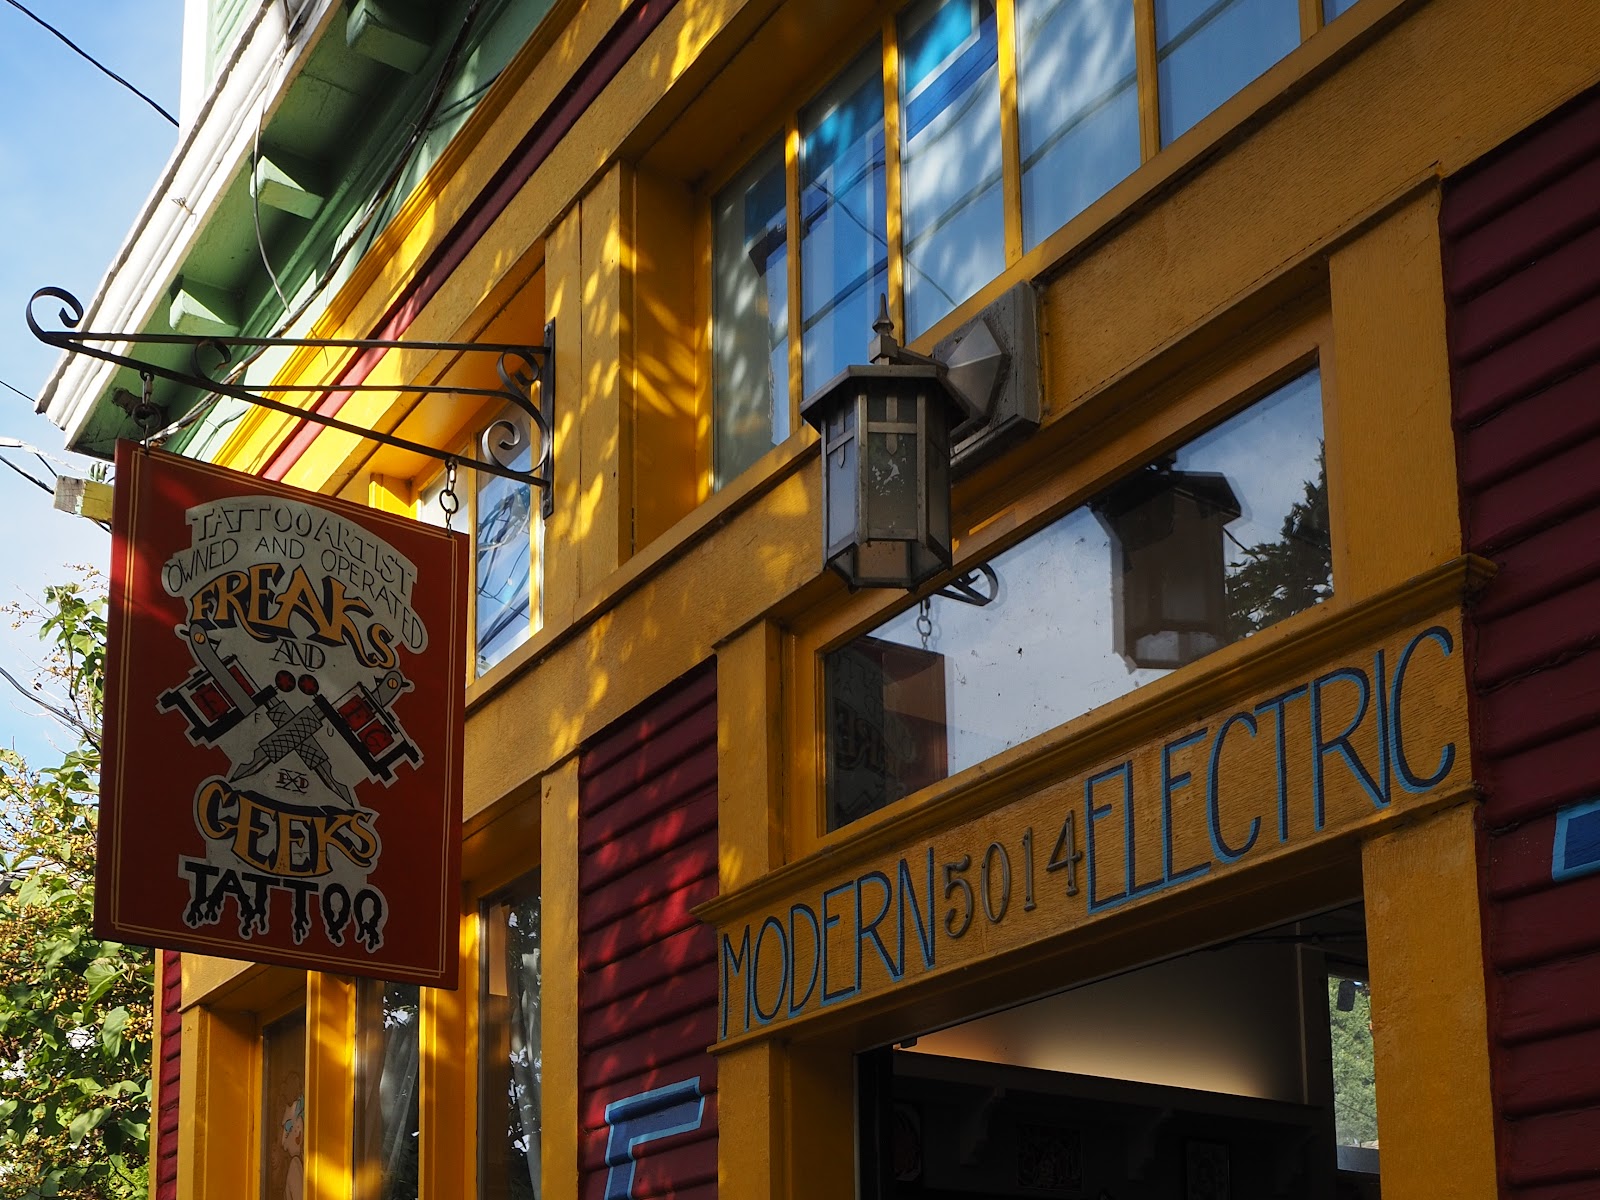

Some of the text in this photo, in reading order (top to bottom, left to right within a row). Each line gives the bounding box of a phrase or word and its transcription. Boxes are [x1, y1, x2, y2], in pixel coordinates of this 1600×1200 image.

[167, 536, 423, 649] OWNED AND OPERATED
[192, 504, 412, 595] TATTOO ARTIST
[190, 562, 396, 669] FREAKS
[269, 638, 325, 672] AND
[197, 780, 378, 878] GEEKS
[719, 846, 937, 1040] MODERN
[942, 809, 1082, 939] 5014
[1085, 625, 1456, 916] ELECTRIC
[185, 861, 382, 949] TATTOO
